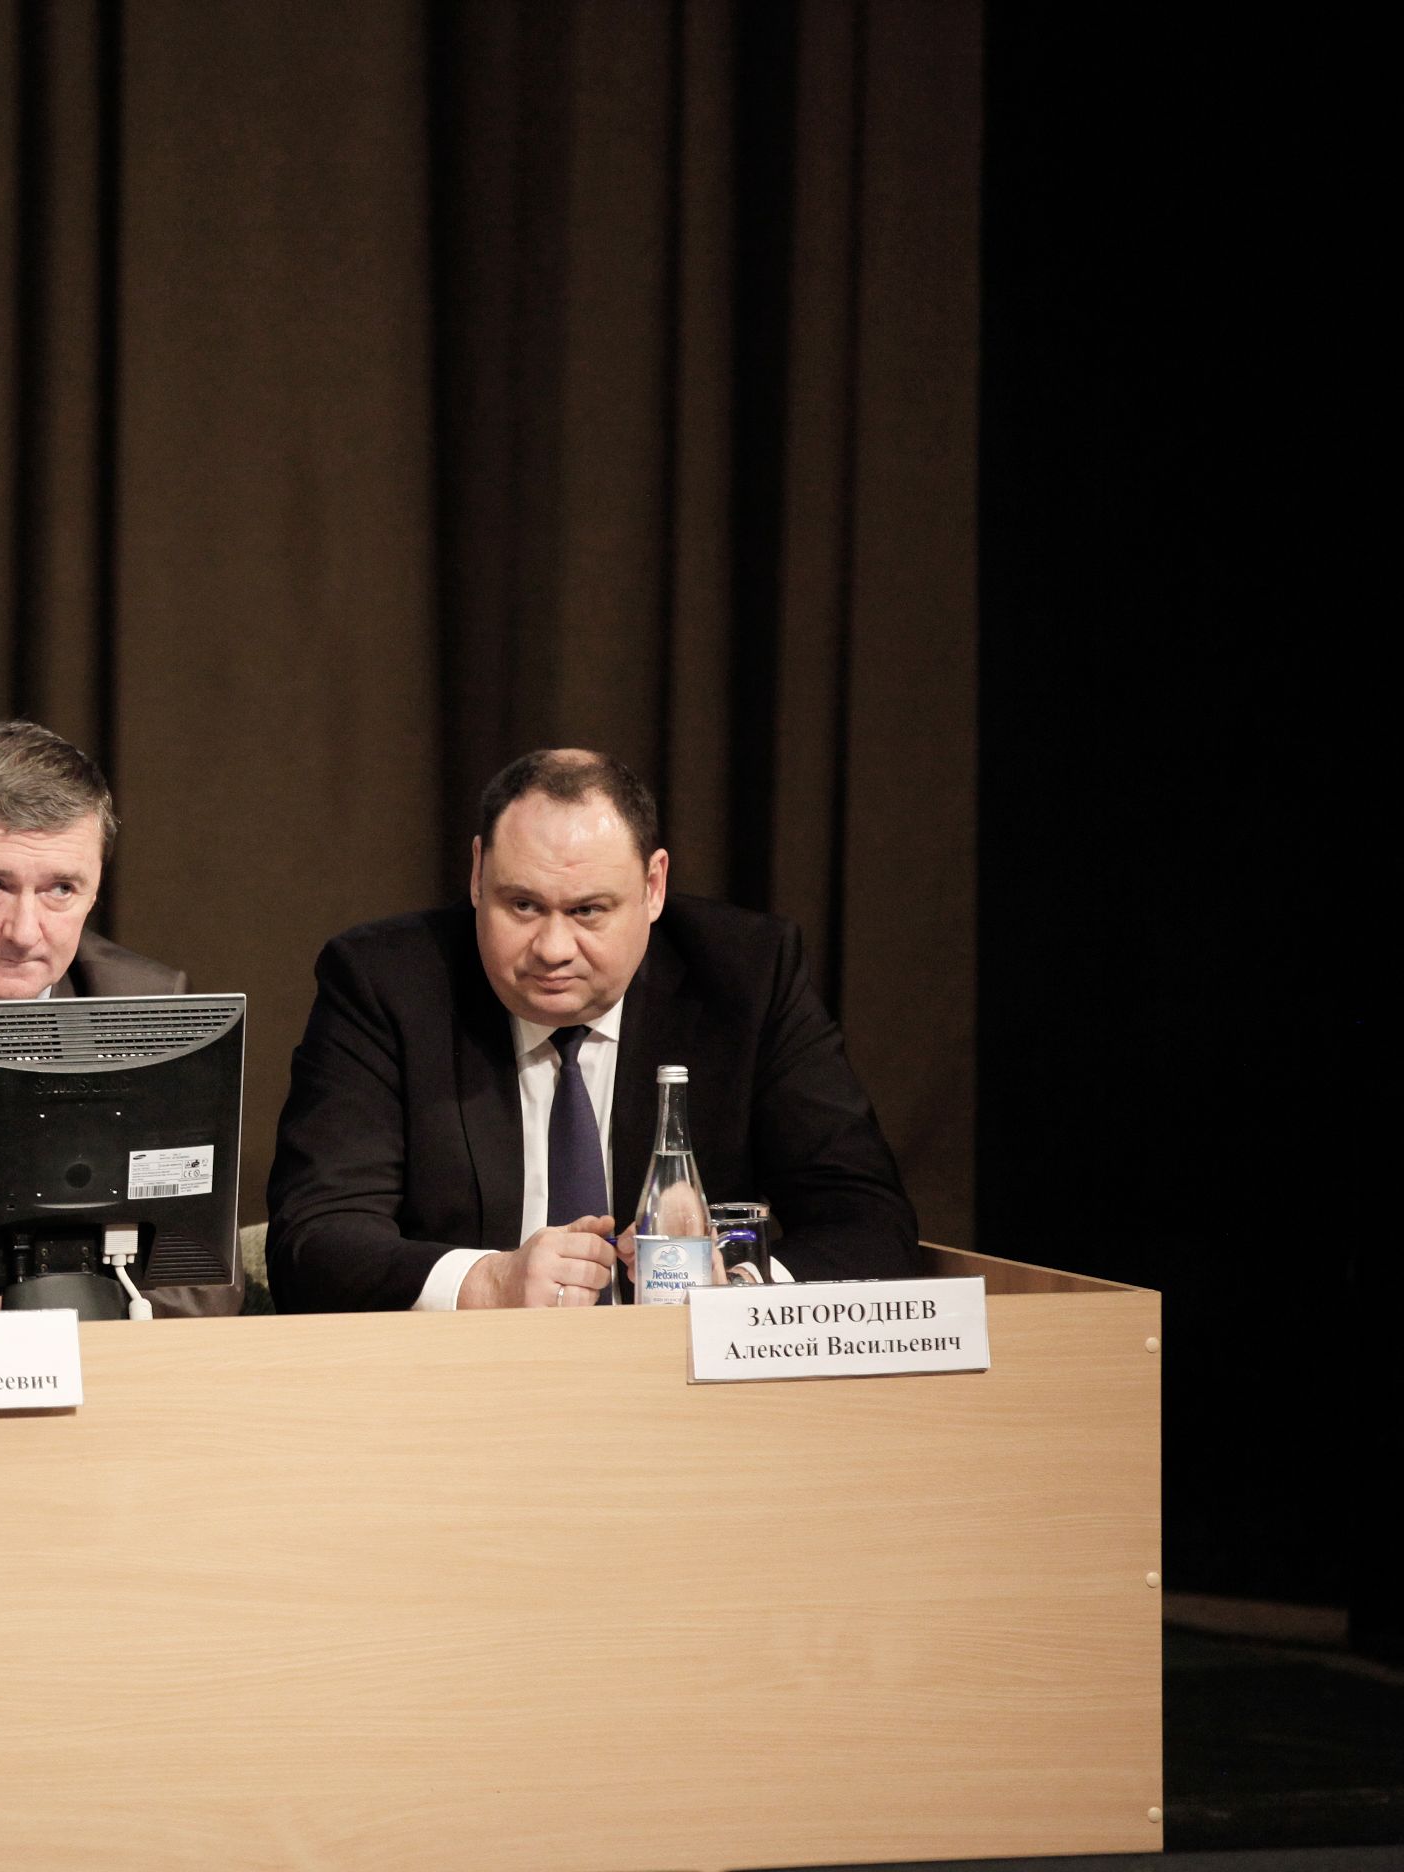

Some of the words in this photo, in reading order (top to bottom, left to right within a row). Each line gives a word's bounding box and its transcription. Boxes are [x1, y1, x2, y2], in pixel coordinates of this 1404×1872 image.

[747, 1300, 937, 1327] ЗАВГОРОДНЕВ
[724, 1338, 819, 1360] Алексей
[827, 1336, 962, 1356] Васильевич
